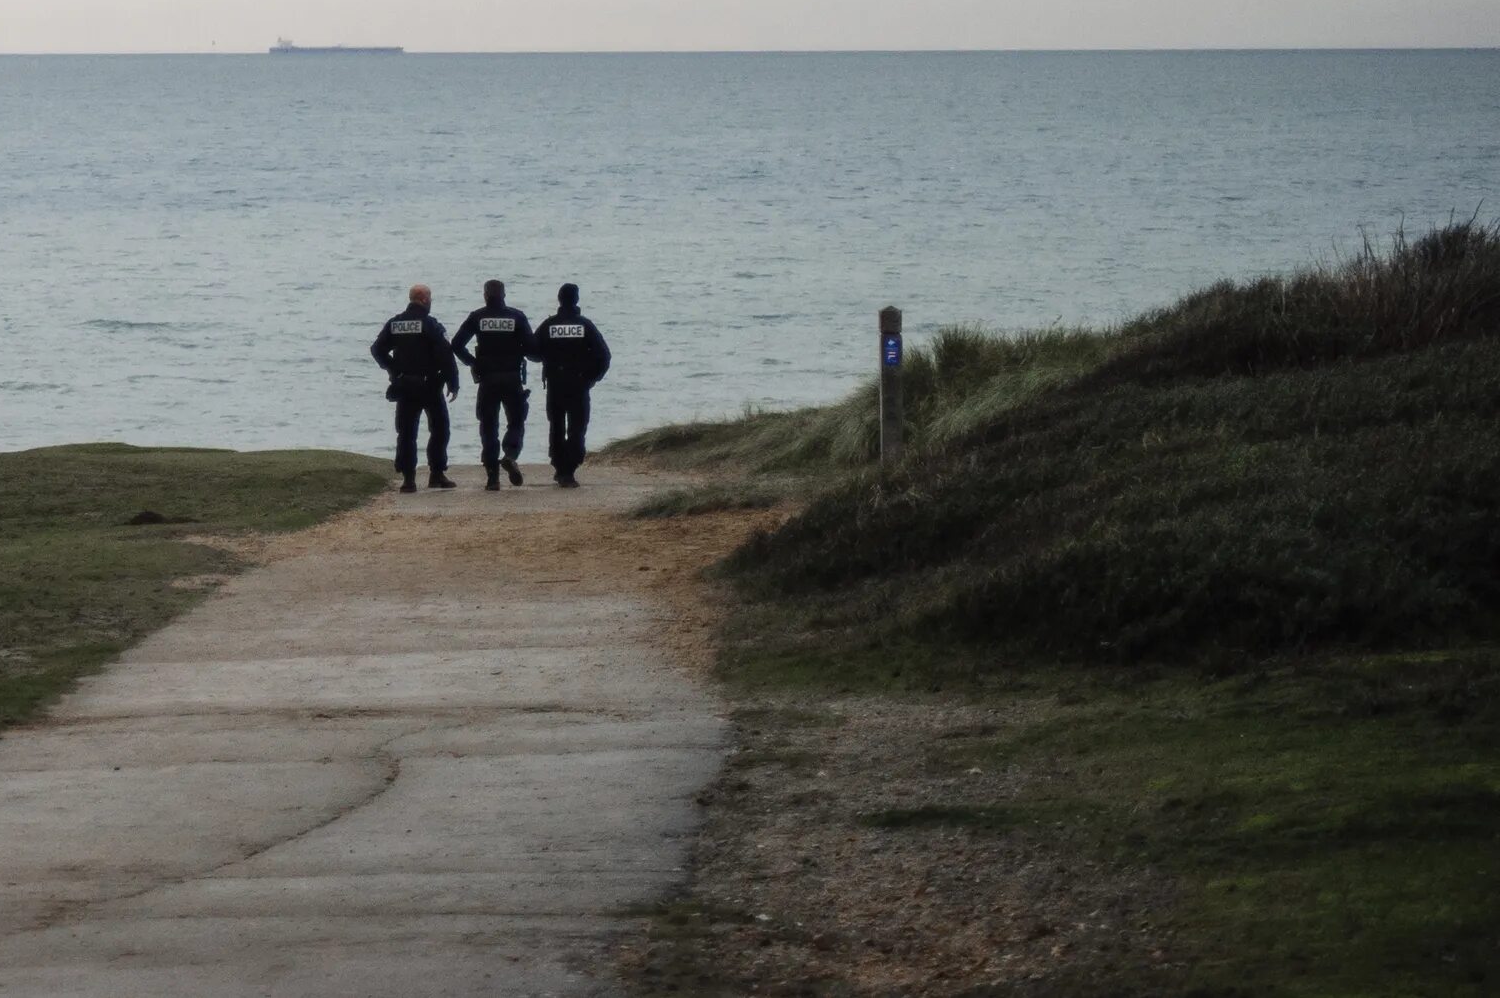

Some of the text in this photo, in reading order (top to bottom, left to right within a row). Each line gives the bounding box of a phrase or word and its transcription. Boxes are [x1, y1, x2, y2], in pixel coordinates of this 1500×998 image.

[392, 321, 420, 332] POLICE
[482, 319, 513, 330] POLICE
[551, 326, 582, 336] POLICE
